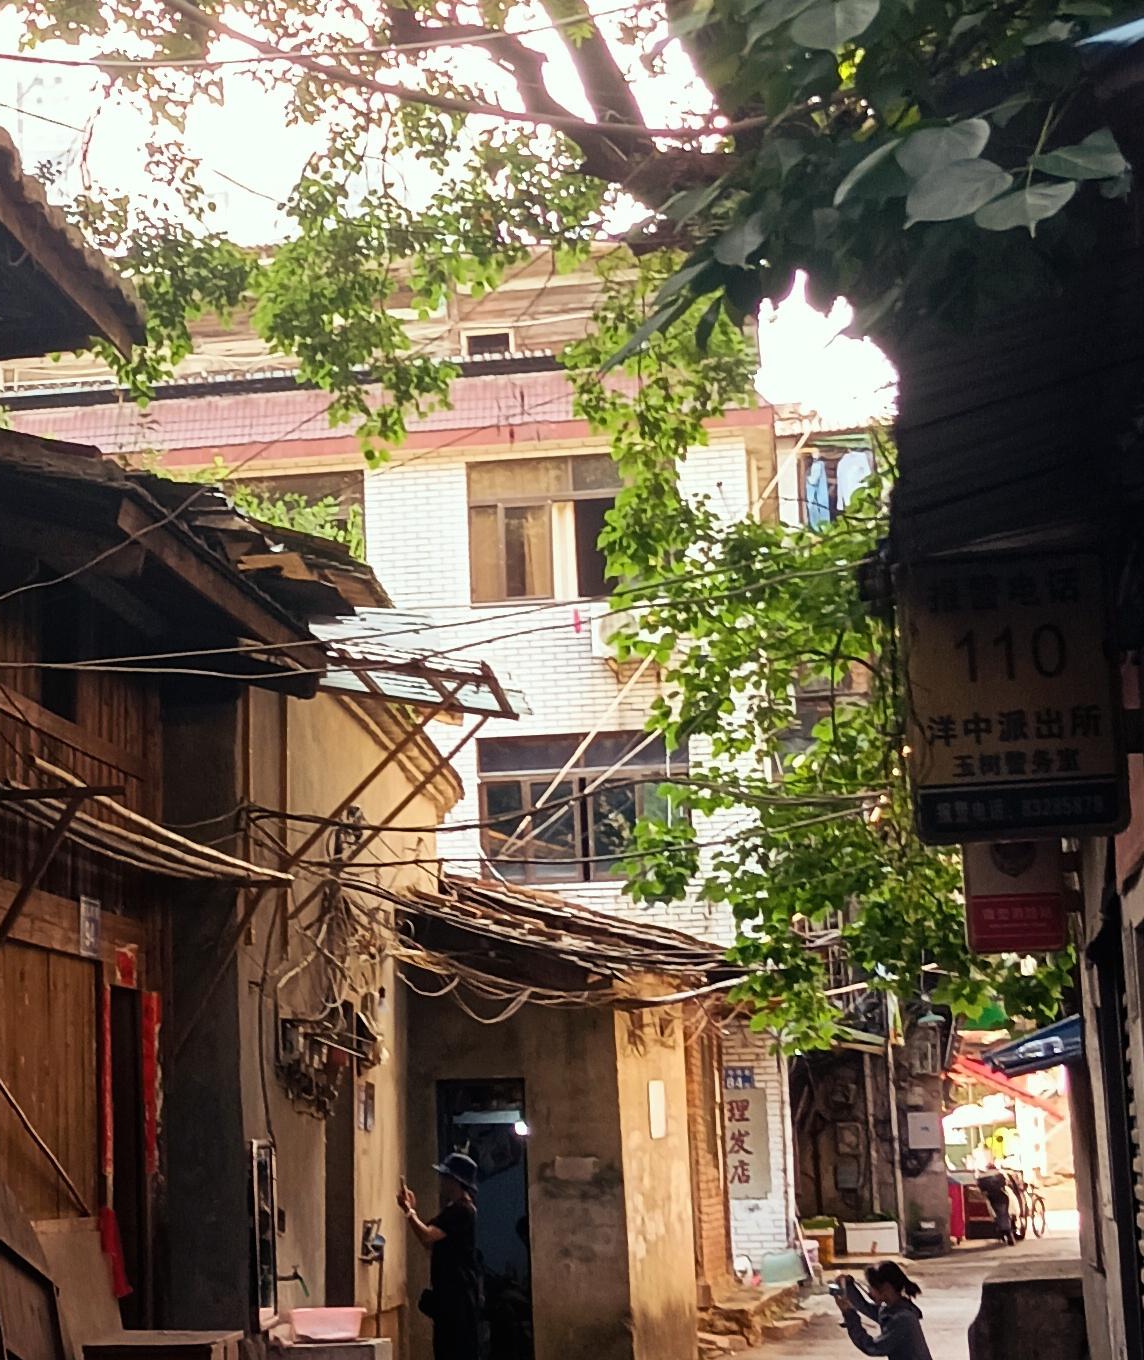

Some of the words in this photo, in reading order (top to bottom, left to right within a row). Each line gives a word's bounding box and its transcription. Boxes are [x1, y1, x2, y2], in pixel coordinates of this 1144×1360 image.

[955, 624, 1067, 683] 110
[927, 704, 1103, 747] 洋中派出所
[726, 1099, 754, 1184] 理发店
